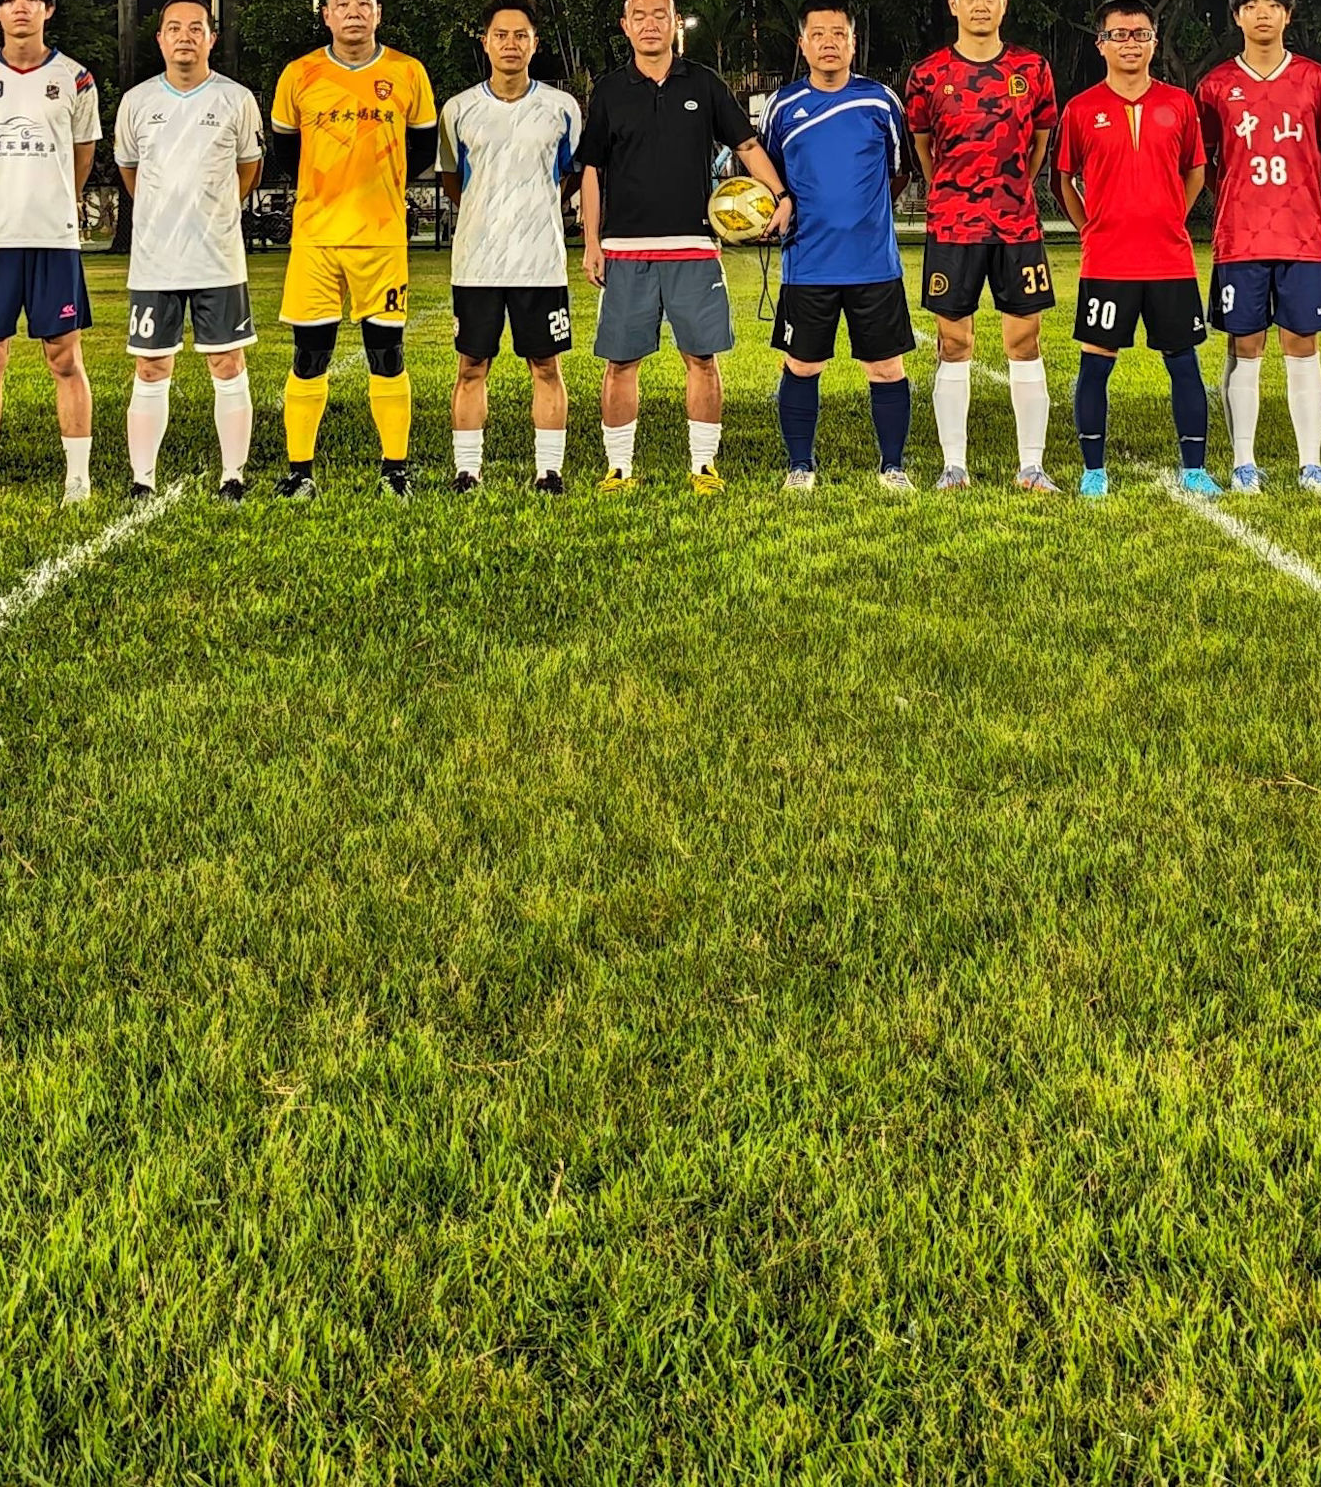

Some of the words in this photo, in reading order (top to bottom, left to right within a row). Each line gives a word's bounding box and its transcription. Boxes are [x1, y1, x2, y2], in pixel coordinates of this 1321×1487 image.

[1233, 110, 1303, 150] 中山
[1250, 156, 1287, 186] 38
[1021, 263, 1050, 295] 33
[129, 304, 155, 339] 66
[548, 307, 570, 336] 26
[1086, 297, 1117, 331] 30
